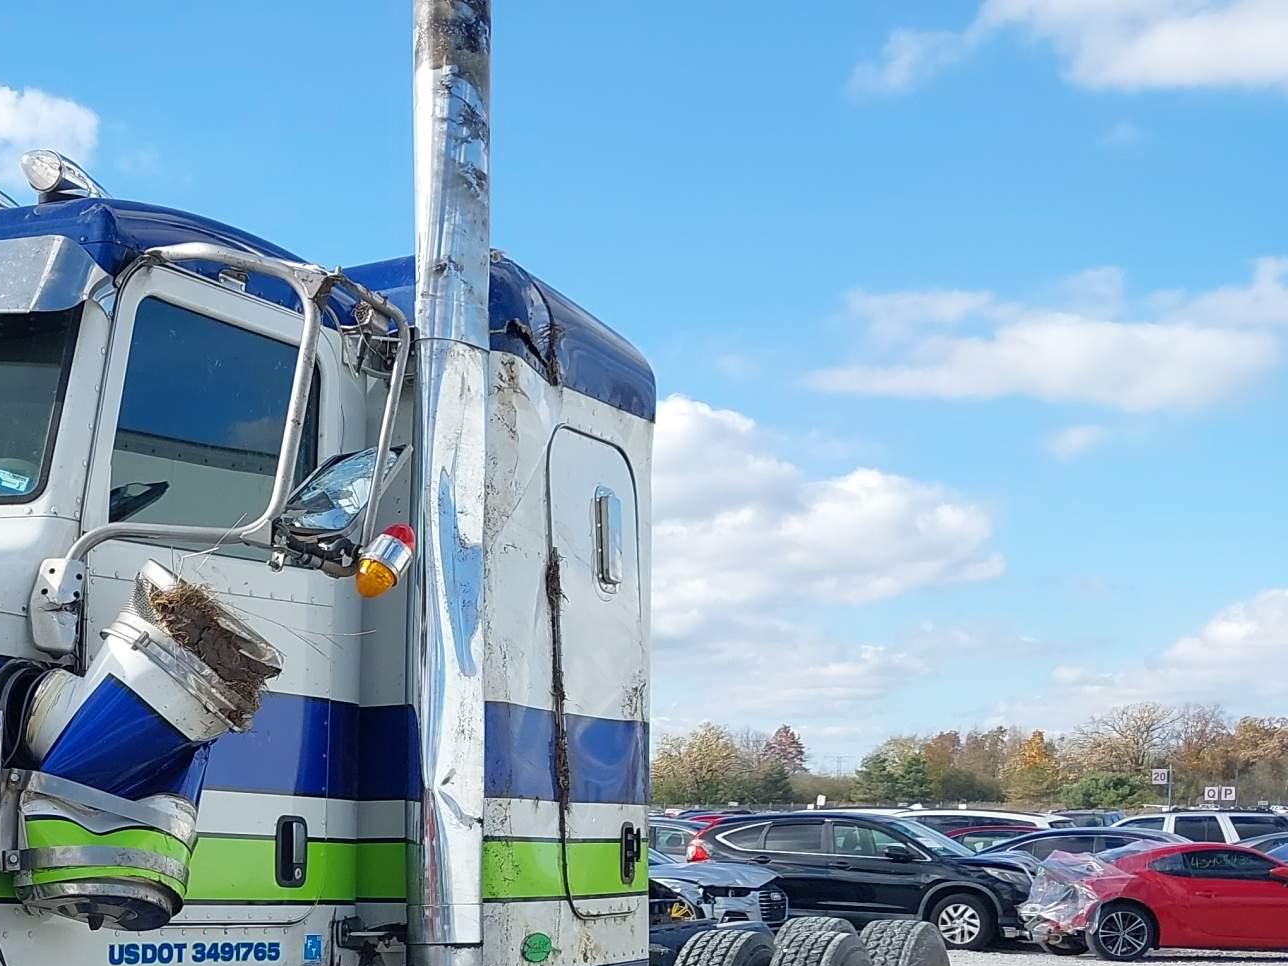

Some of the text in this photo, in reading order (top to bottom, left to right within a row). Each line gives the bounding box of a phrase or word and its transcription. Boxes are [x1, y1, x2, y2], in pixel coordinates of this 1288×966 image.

[1153, 772, 1166, 782] 20
[1207, 788, 1216, 798] Q
[1224, 788, 1233, 799] P
[108, 942, 281, 966] USDOT 3491765
